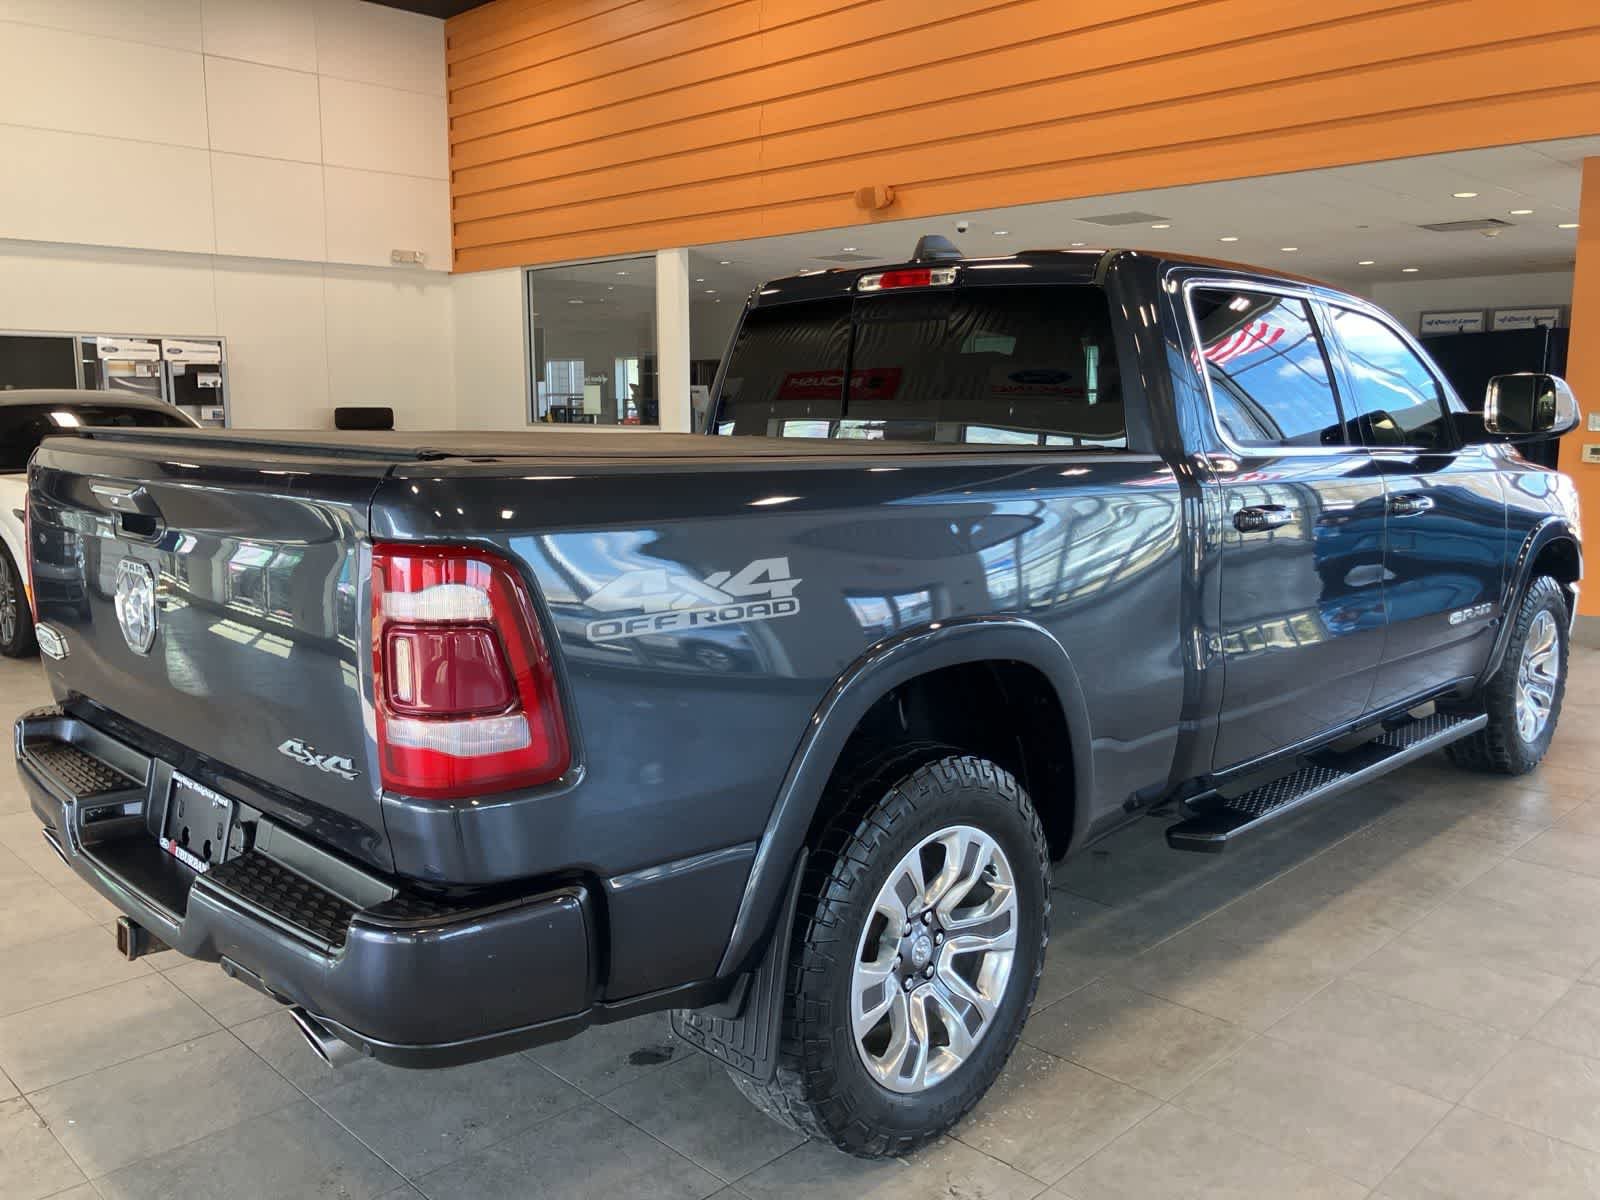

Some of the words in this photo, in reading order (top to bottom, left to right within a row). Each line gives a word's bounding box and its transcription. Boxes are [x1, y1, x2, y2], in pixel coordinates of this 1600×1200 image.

[120, 560, 146, 575] RAM
[591, 613, 678, 638] OFF
[690, 600, 796, 624] ROAD
